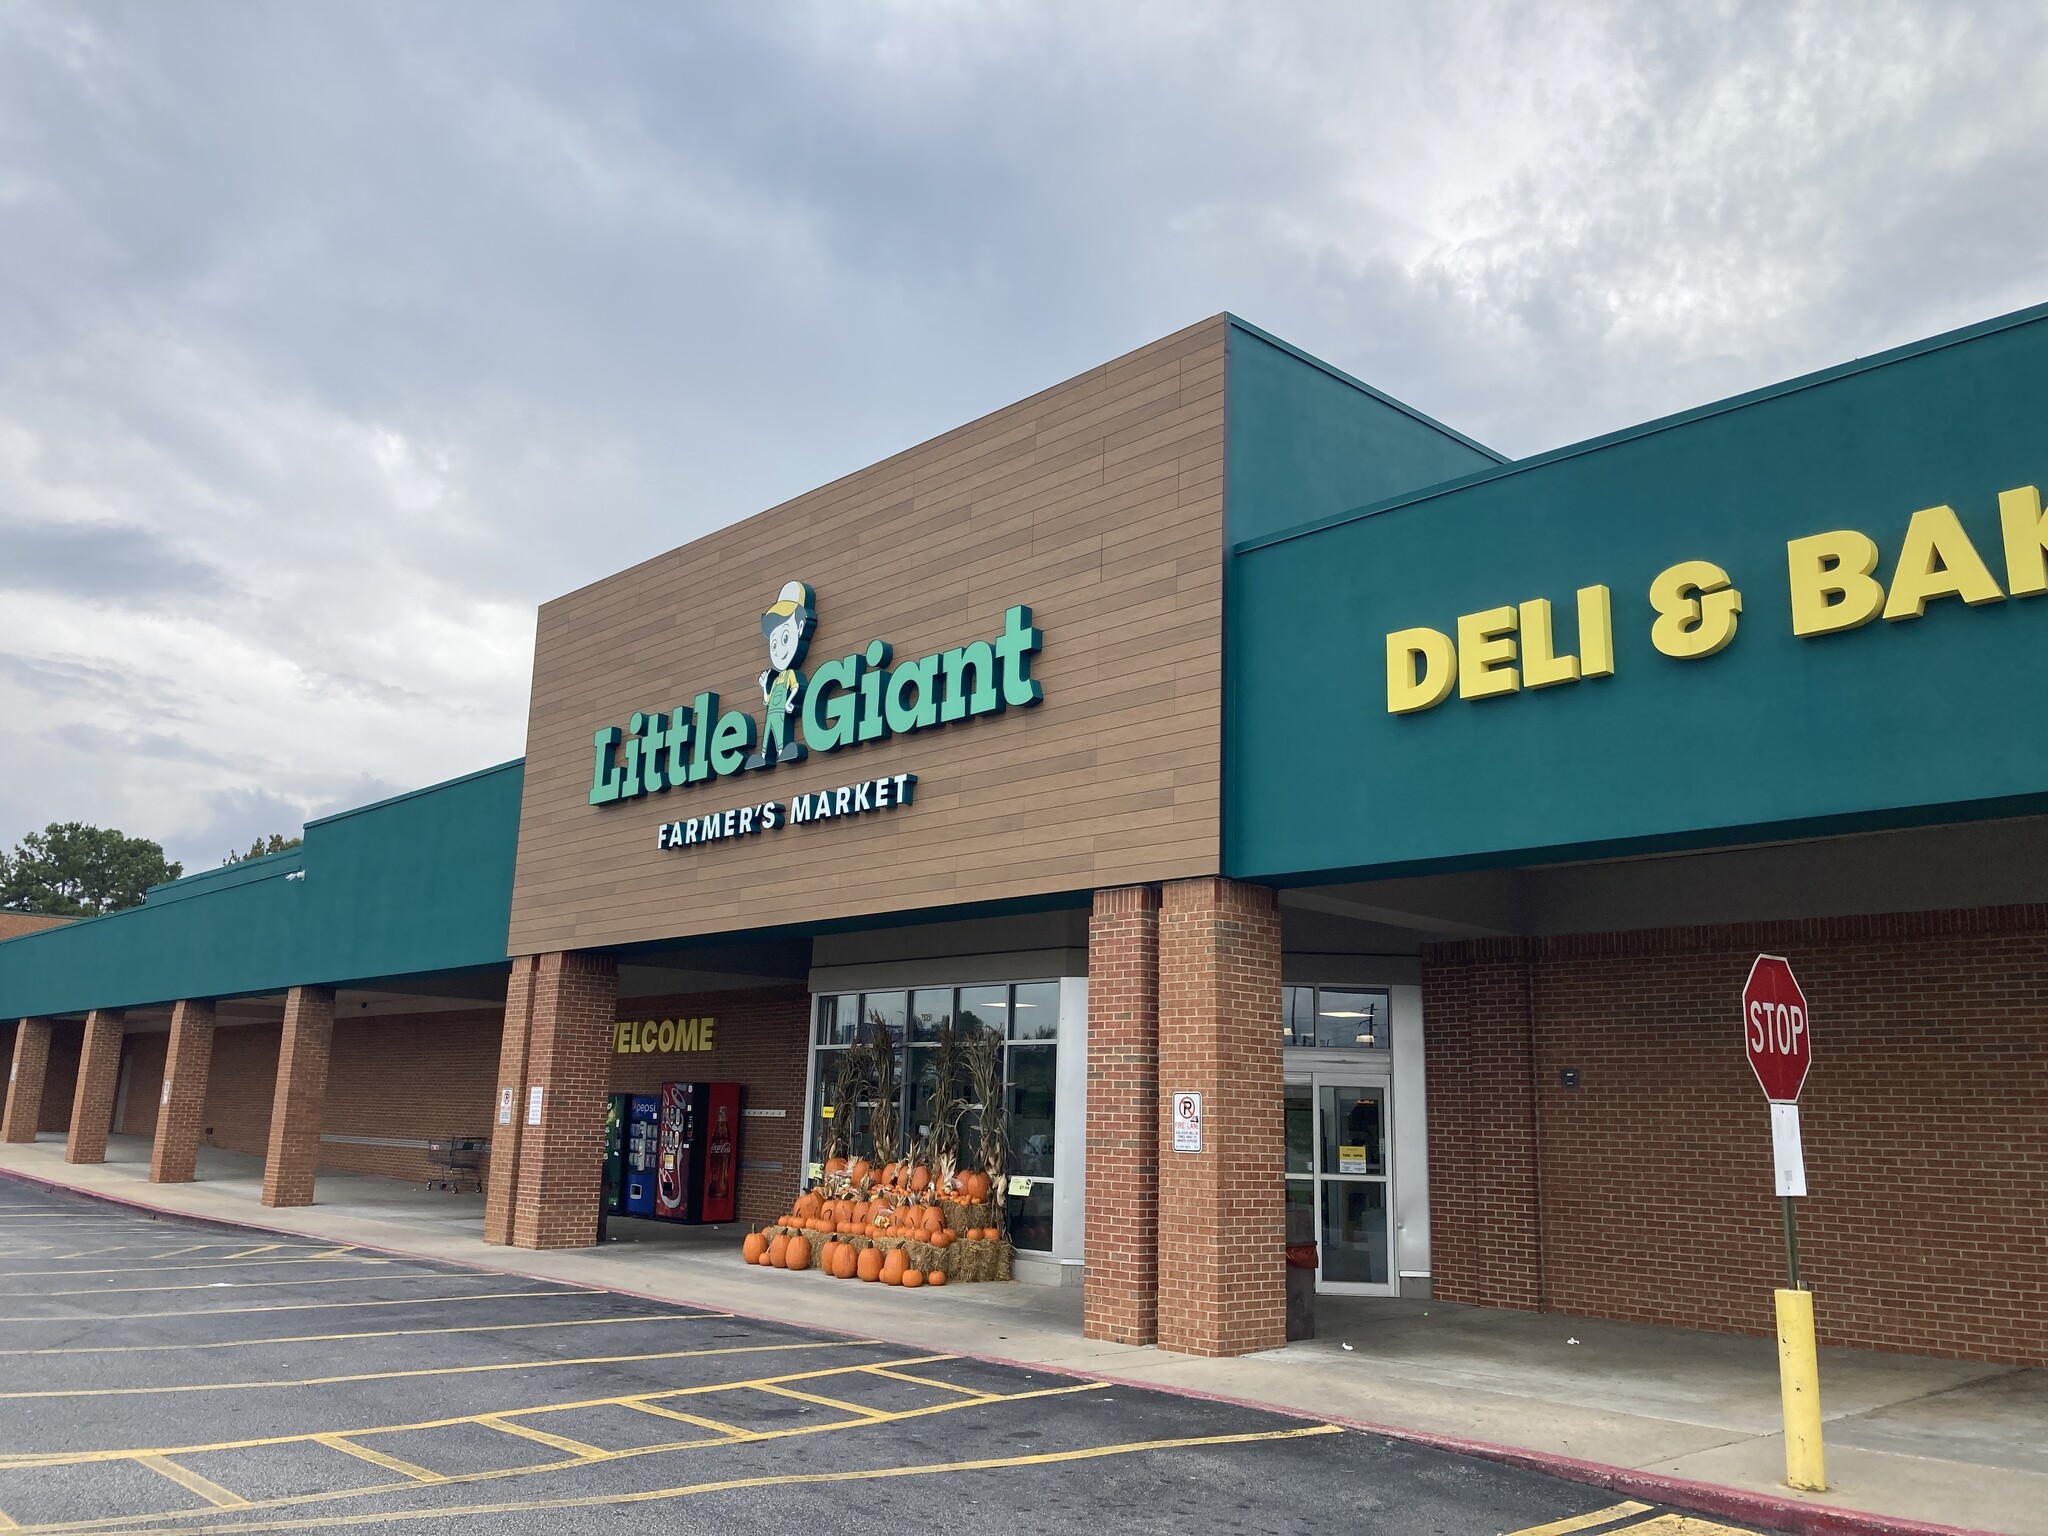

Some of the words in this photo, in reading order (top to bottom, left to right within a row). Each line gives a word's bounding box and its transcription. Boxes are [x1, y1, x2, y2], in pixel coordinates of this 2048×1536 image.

[1386, 584, 1614, 714] DELI
[1649, 560, 1742, 659] &
[589, 692, 756, 805] Little
[801, 604, 1043, 752] Giant
[657, 801, 785, 850] FARMER'S
[790, 773, 917, 825] MARKET
[612, 1017, 715, 1053] ELCOME
[1750, 1000, 1804, 1055] STOP
[636, 1102, 656, 1114] pepsi
